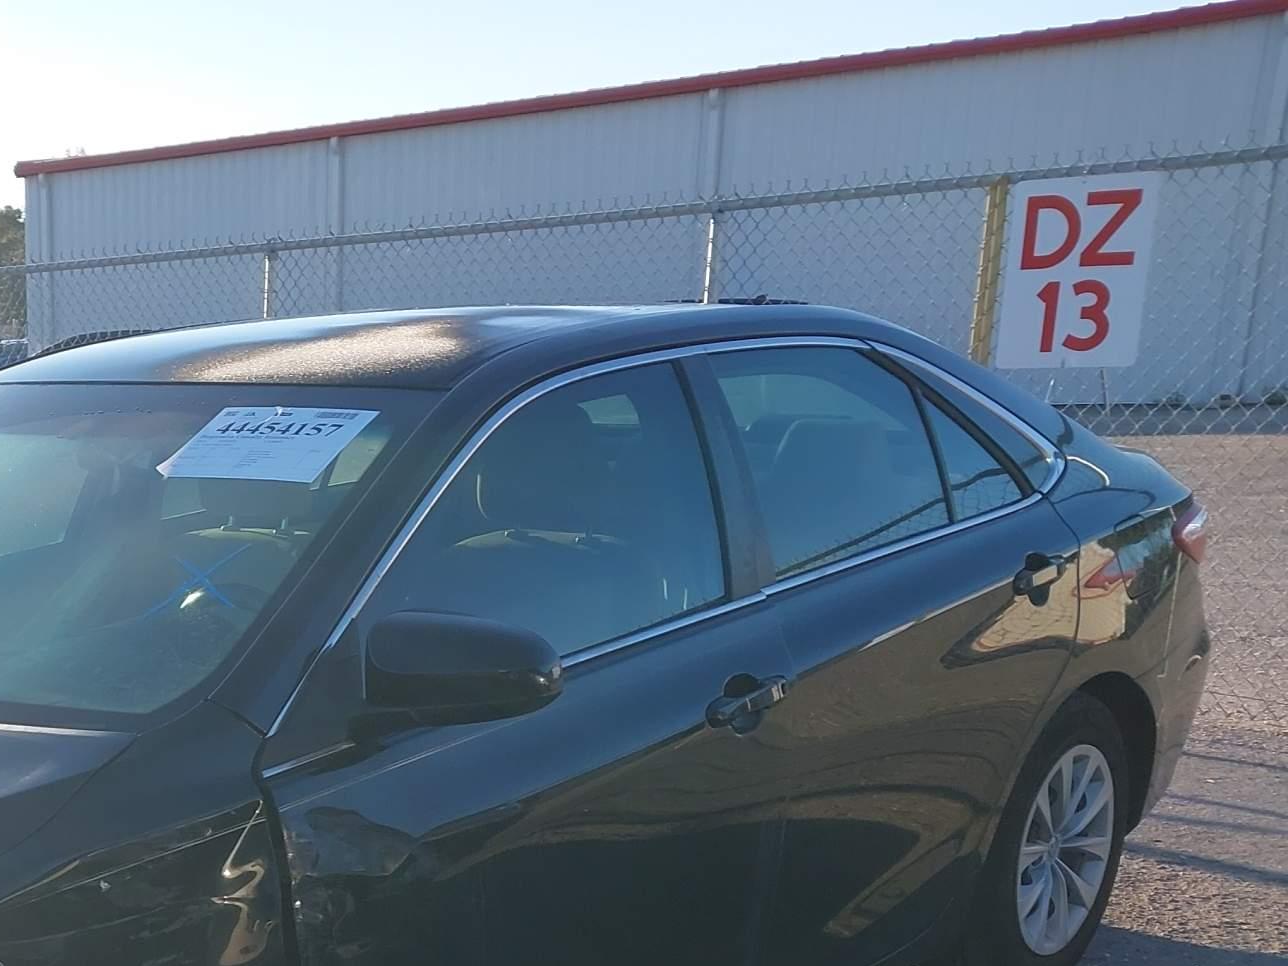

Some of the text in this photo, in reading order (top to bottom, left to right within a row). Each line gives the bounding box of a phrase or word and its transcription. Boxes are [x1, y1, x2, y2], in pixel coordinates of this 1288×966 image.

[1020, 188, 1144, 270] DZ
[1036, 279, 1111, 353] 13
[215, 421, 345, 437] 44454157
